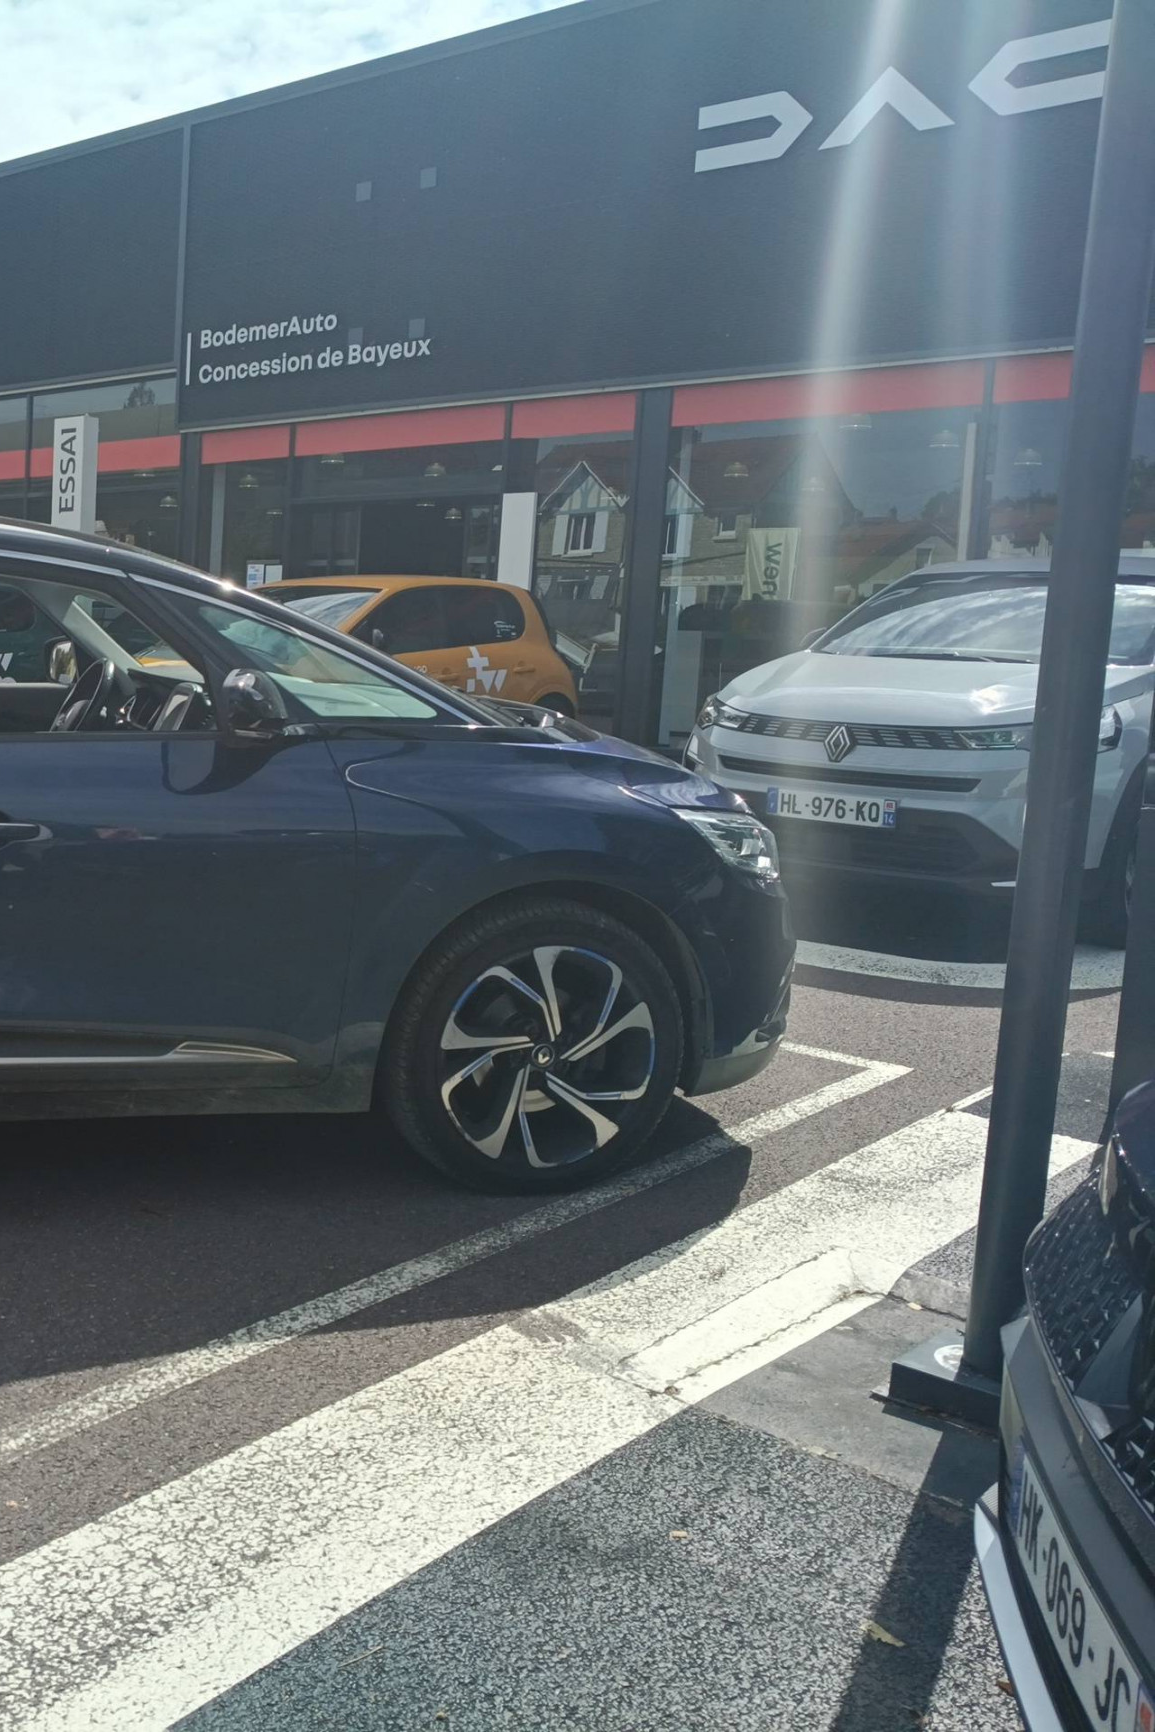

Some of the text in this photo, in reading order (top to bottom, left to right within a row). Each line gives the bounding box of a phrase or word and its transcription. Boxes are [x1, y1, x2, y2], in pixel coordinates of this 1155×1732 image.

[199, 313, 338, 349] BodemerAuto
[198, 338, 432, 384] Concession de Bayeux
[59, 427, 77, 514] ESSAI
[780, 793, 880, 823] HL-976-KQ
